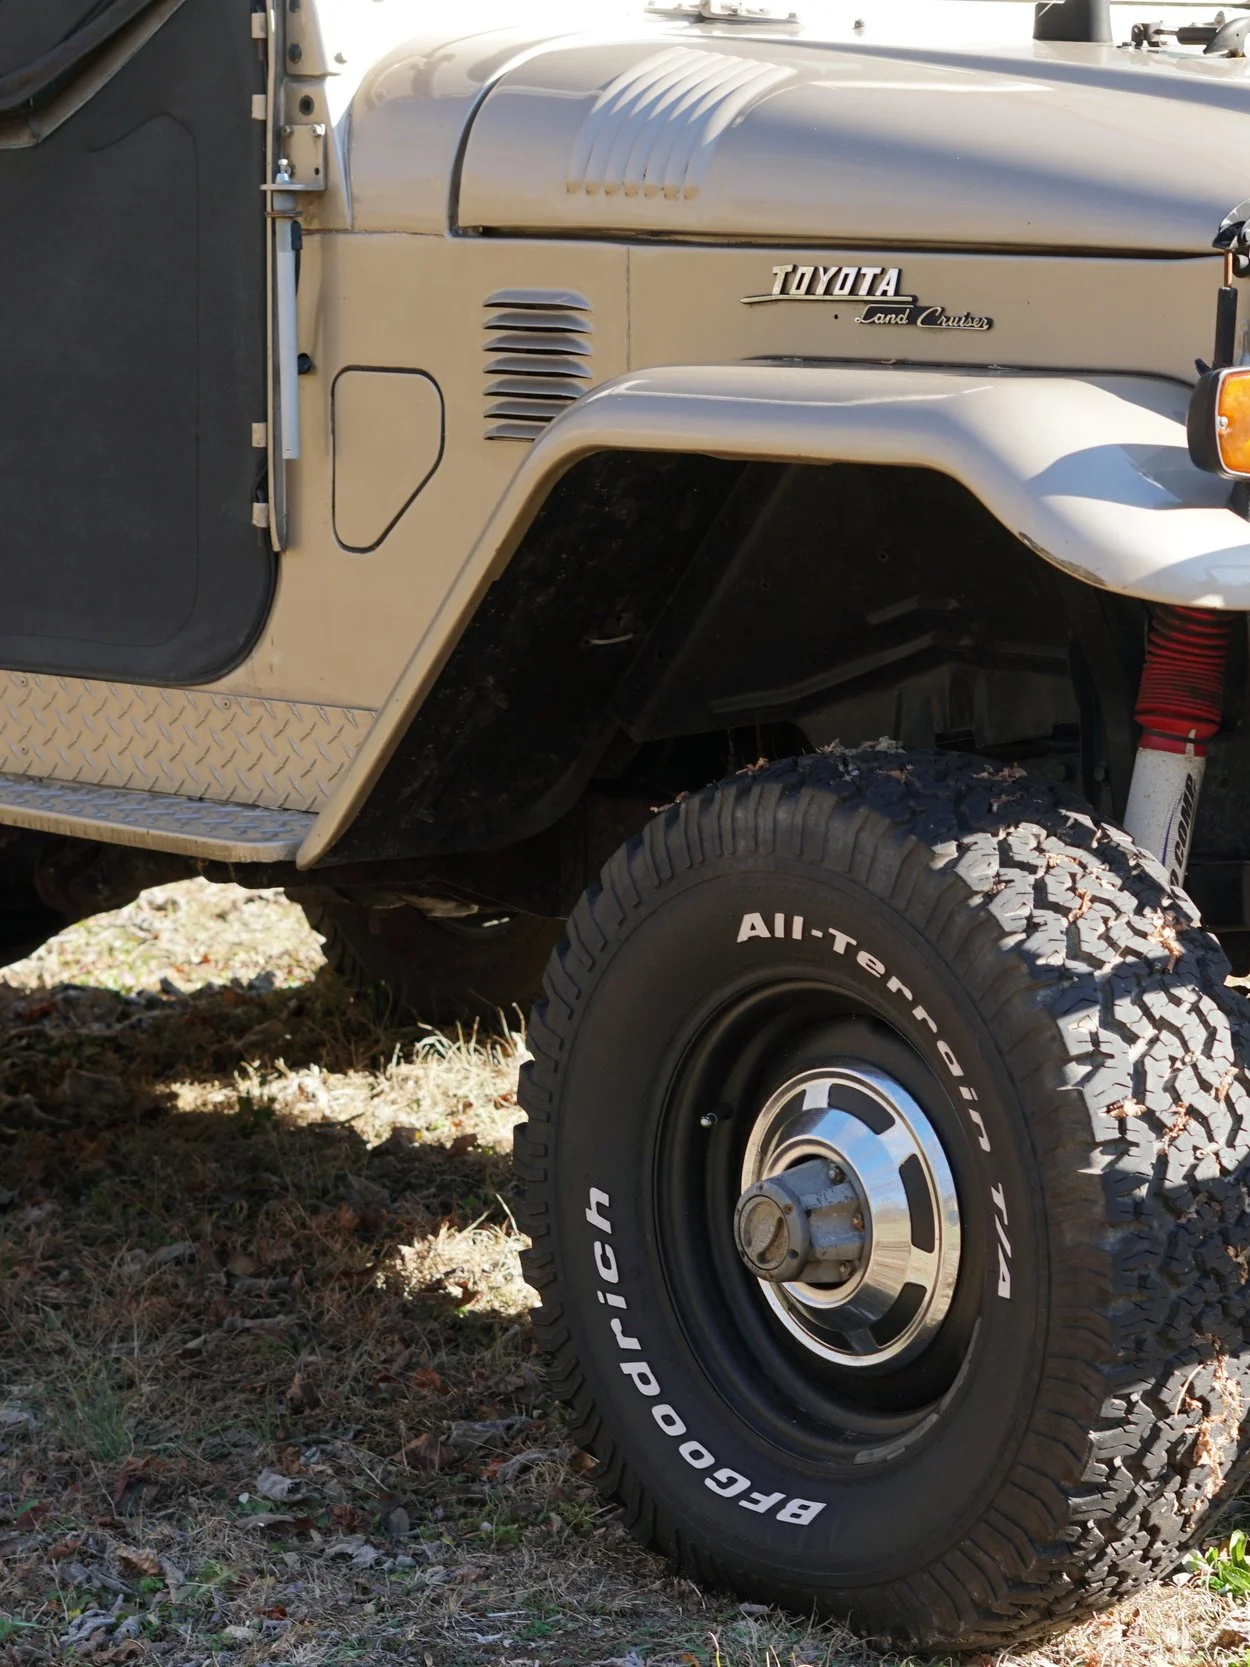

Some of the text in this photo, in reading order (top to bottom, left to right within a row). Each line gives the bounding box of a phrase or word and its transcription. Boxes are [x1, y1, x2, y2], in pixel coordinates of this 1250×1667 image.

[771, 263, 900, 296] TOYOTA
[854, 303, 992, 330] Land Cruiser
[736, 912, 1012, 1299] All-Terrain T/A
[585, 1187, 828, 1526] BFGoodrich
